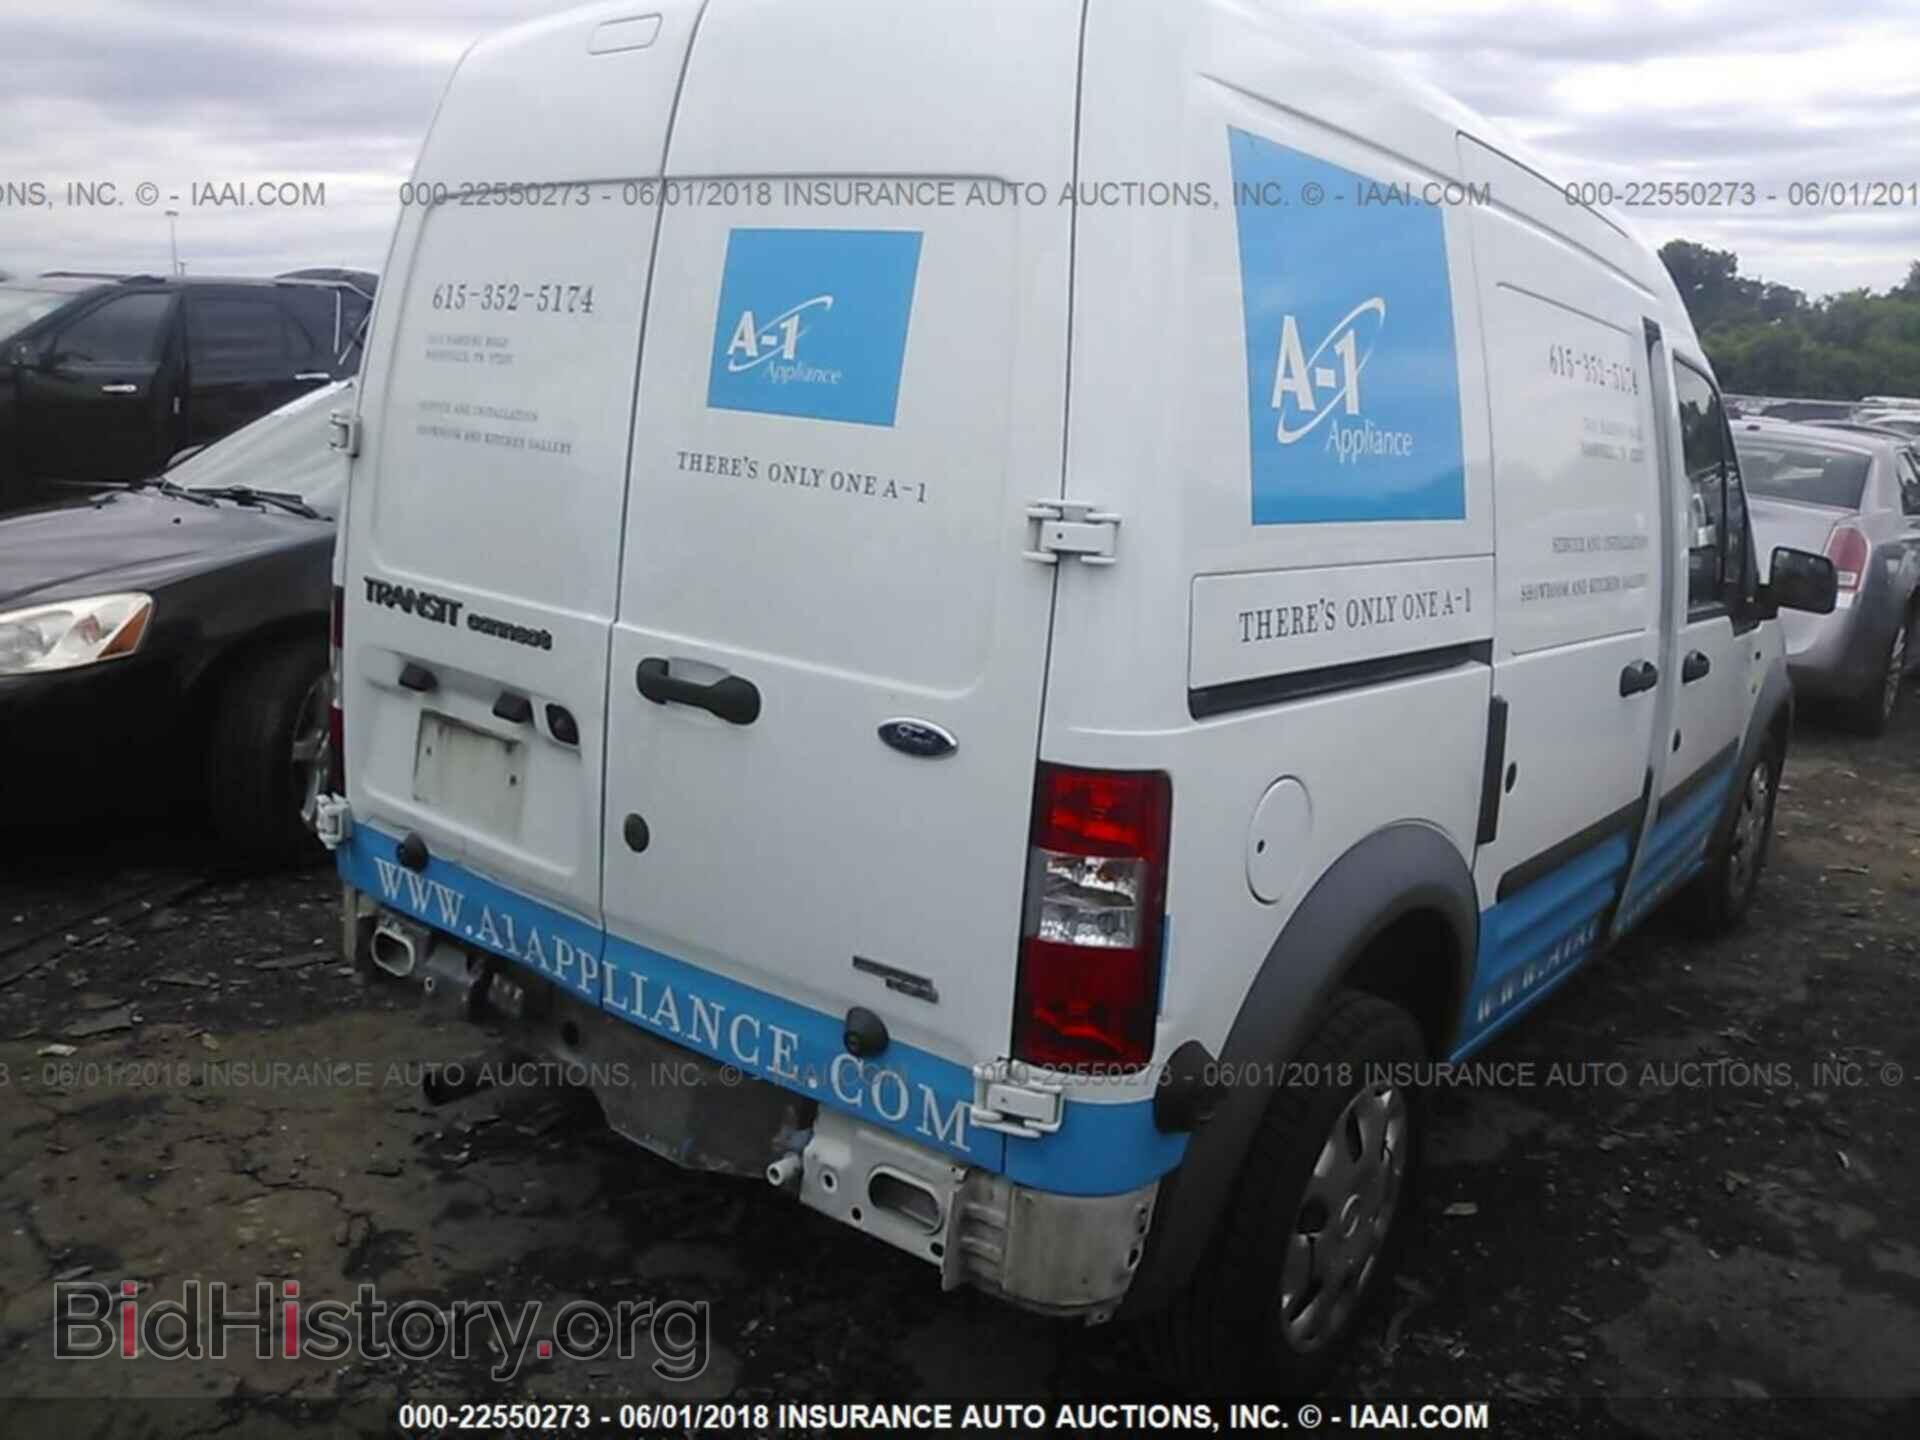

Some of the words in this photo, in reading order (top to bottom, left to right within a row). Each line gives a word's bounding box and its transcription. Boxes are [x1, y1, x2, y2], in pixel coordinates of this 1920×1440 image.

[432, 282, 594, 314] 615-352-5174
[727, 309, 800, 361] A-1
[762, 360, 843, 385] Appliance
[1271, 314, 1360, 415] A-1
[1325, 418, 1413, 464] Appliance
[676, 451, 759, 480] THERE'S
[767, 463, 825, 489] ONLY
[830, 470, 877, 496] ONE
[882, 479, 928, 504] A-1
[362, 575, 464, 627] TRANSIT
[1239, 597, 1336, 644] THERE'S
[1346, 595, 1398, 628] ONLY
[1402, 590, 1438, 621] ONE
[1442, 587, 1472, 616] A-1
